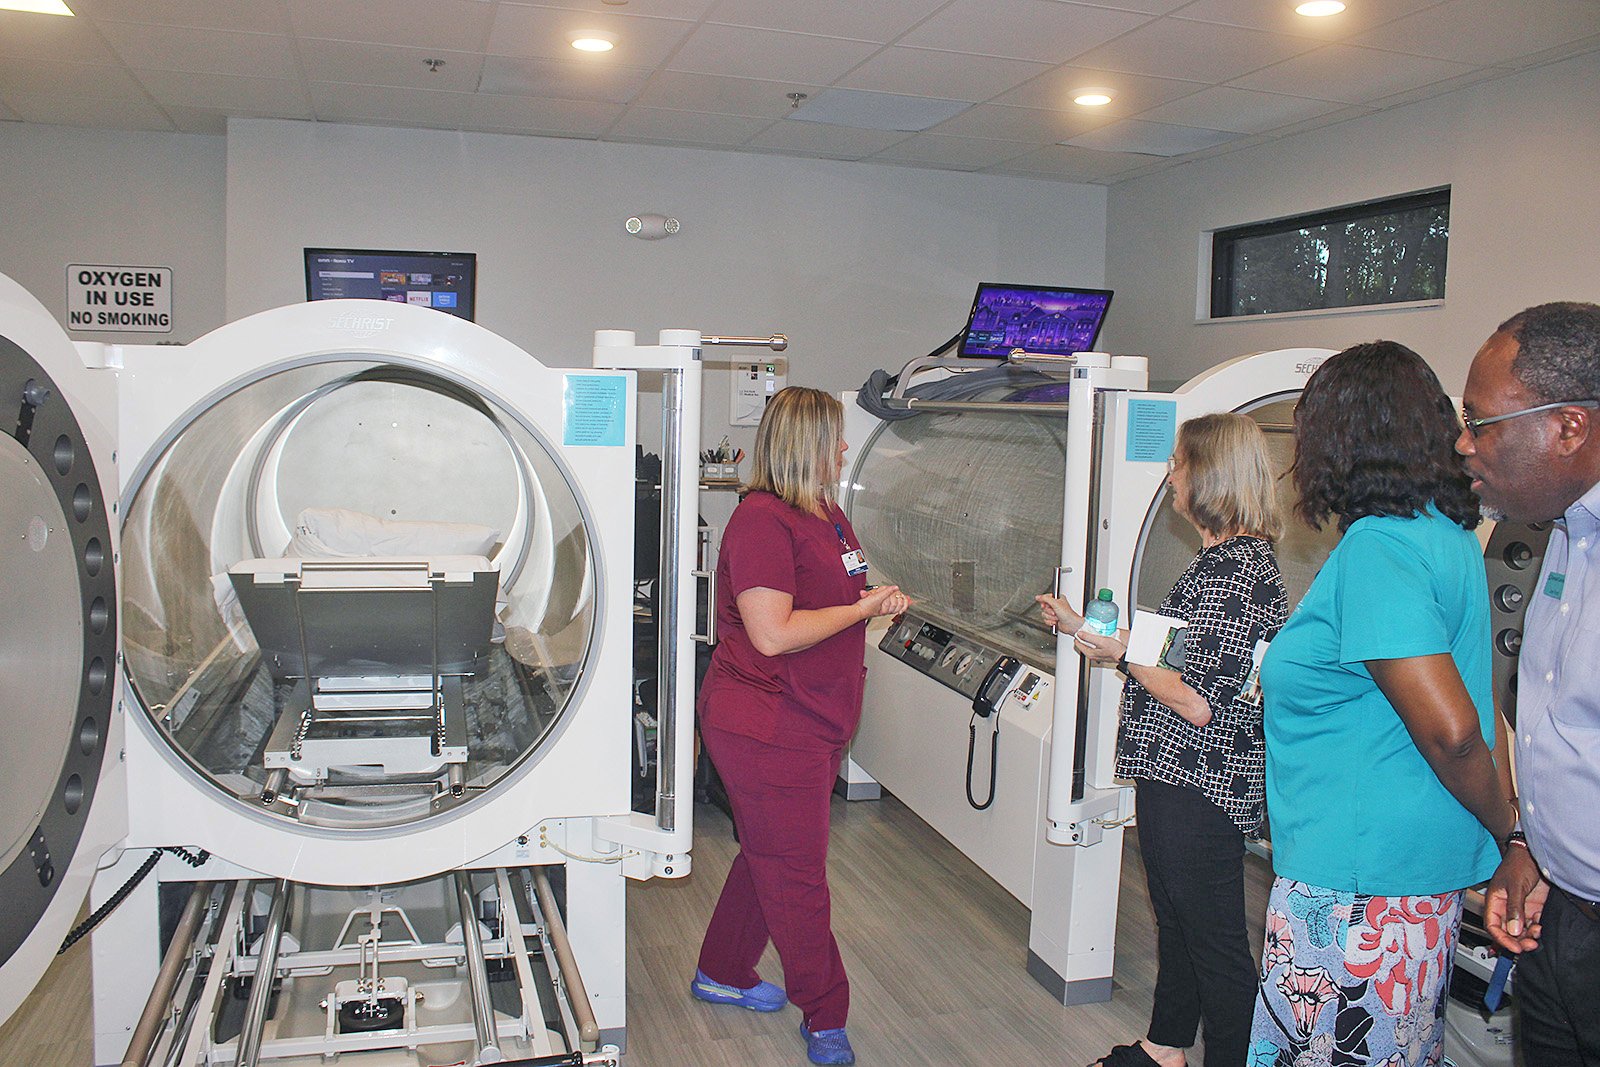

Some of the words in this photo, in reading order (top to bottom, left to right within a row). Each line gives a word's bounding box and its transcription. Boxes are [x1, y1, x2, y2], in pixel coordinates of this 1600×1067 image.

[78, 271, 161, 287] OXYGEN
[86, 290, 107, 305] IN
[115, 291, 154, 306] USE
[71, 311, 92, 324] NO
[98, 312, 169, 326] SMOKING
[327, 316, 395, 330] SECHRIST
[1294, 363, 1320, 374] SECH
